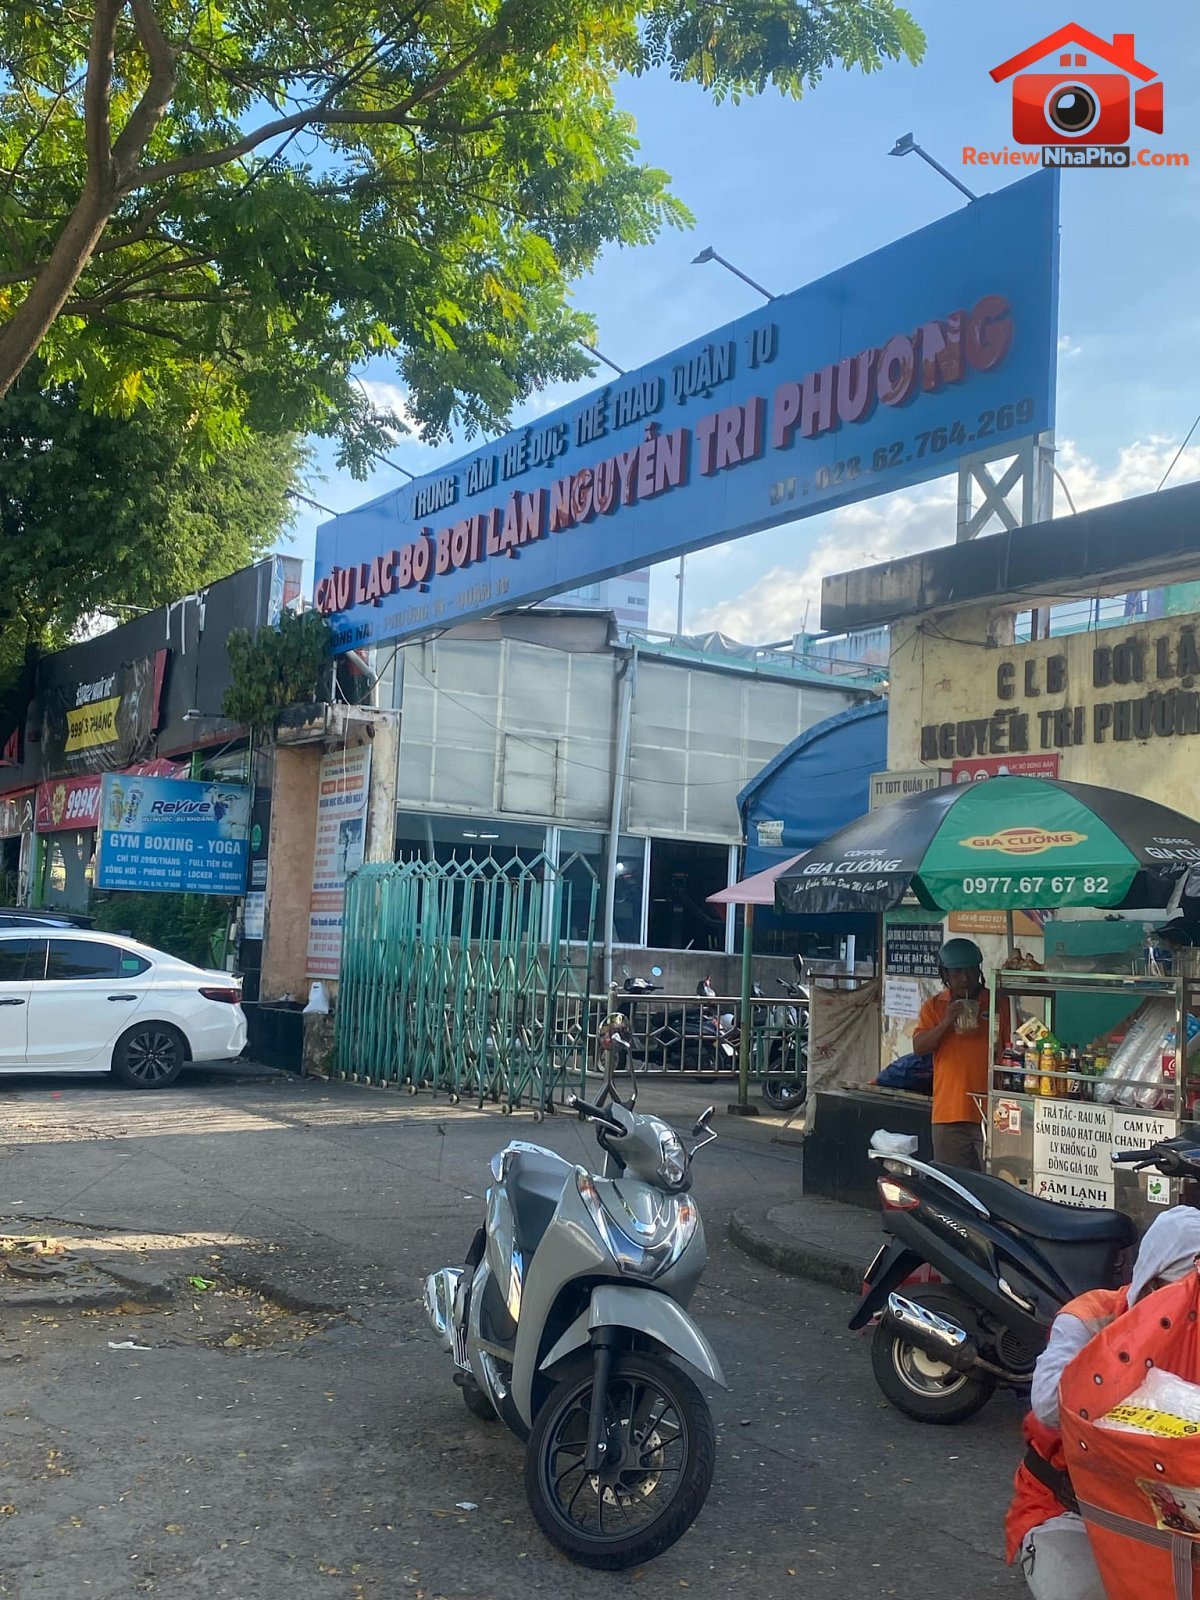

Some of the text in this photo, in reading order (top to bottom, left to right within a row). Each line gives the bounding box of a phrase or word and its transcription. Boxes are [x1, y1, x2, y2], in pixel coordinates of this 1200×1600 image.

[412, 474, 459, 520] TRUNG
[464, 457, 499, 496] TÂM
[531, 422, 567, 468] DỤC
[611, 376, 664, 430] THAO
[671, 341, 736, 406] QUẬN
[746, 323, 779, 369] 10
[356, 550, 399, 608] LẠC
[400, 527, 433, 593] BỘ
[435, 513, 487, 575] BƠI
[549, 422, 691, 533] NGUYỄN
[696, 396, 766, 477] TRI
[773, 294, 1015, 450] PHƯƠNG
[355, 620, 373, 643] NAI
[1092, 636, 1147, 688] BƠI
[1037, 706, 1086, 749] TRI
[1093, 688, 1200, 744] PHƯƠN
[110, 833, 140, 849] GYM
[144, 836, 194, 852] BOXING
[208, 839, 241, 855] YOGA
[972, 832, 1074, 847] GIA CƯỜNG
[189, 858, 205, 867] FULL
[1144, 846, 1183, 860] GIA
[188, 870, 213, 879] LOCKER
[803, 858, 903, 875] GIA CƯỜNG
[962, 876, 1109, 894] 0977.67 67 82
[891, 952, 903, 963] LIÊN
[903, 952, 911, 964] HỆ
[1043, 1106, 1057, 1119] TRÀ
[1058, 1103, 1073, 1120] TẮC
[1078, 1111, 1093, 1124] RAU
[1094, 1108, 1107, 1126] MÁ
[1036, 1122, 1113, 1144] SÂM BÍ ĐAO HẠT CHIA
[1123, 1119, 1165, 1135] CAM VẮT
[1050, 1138, 1097, 1158] LY KHỔNG LỒ
[1114, 1137, 1147, 1149] CHANH
[1048, 1156, 1099, 1177] ĐỒNG GIÁ 10K
[1040, 1179, 1108, 1202] SÂM LẠNH
